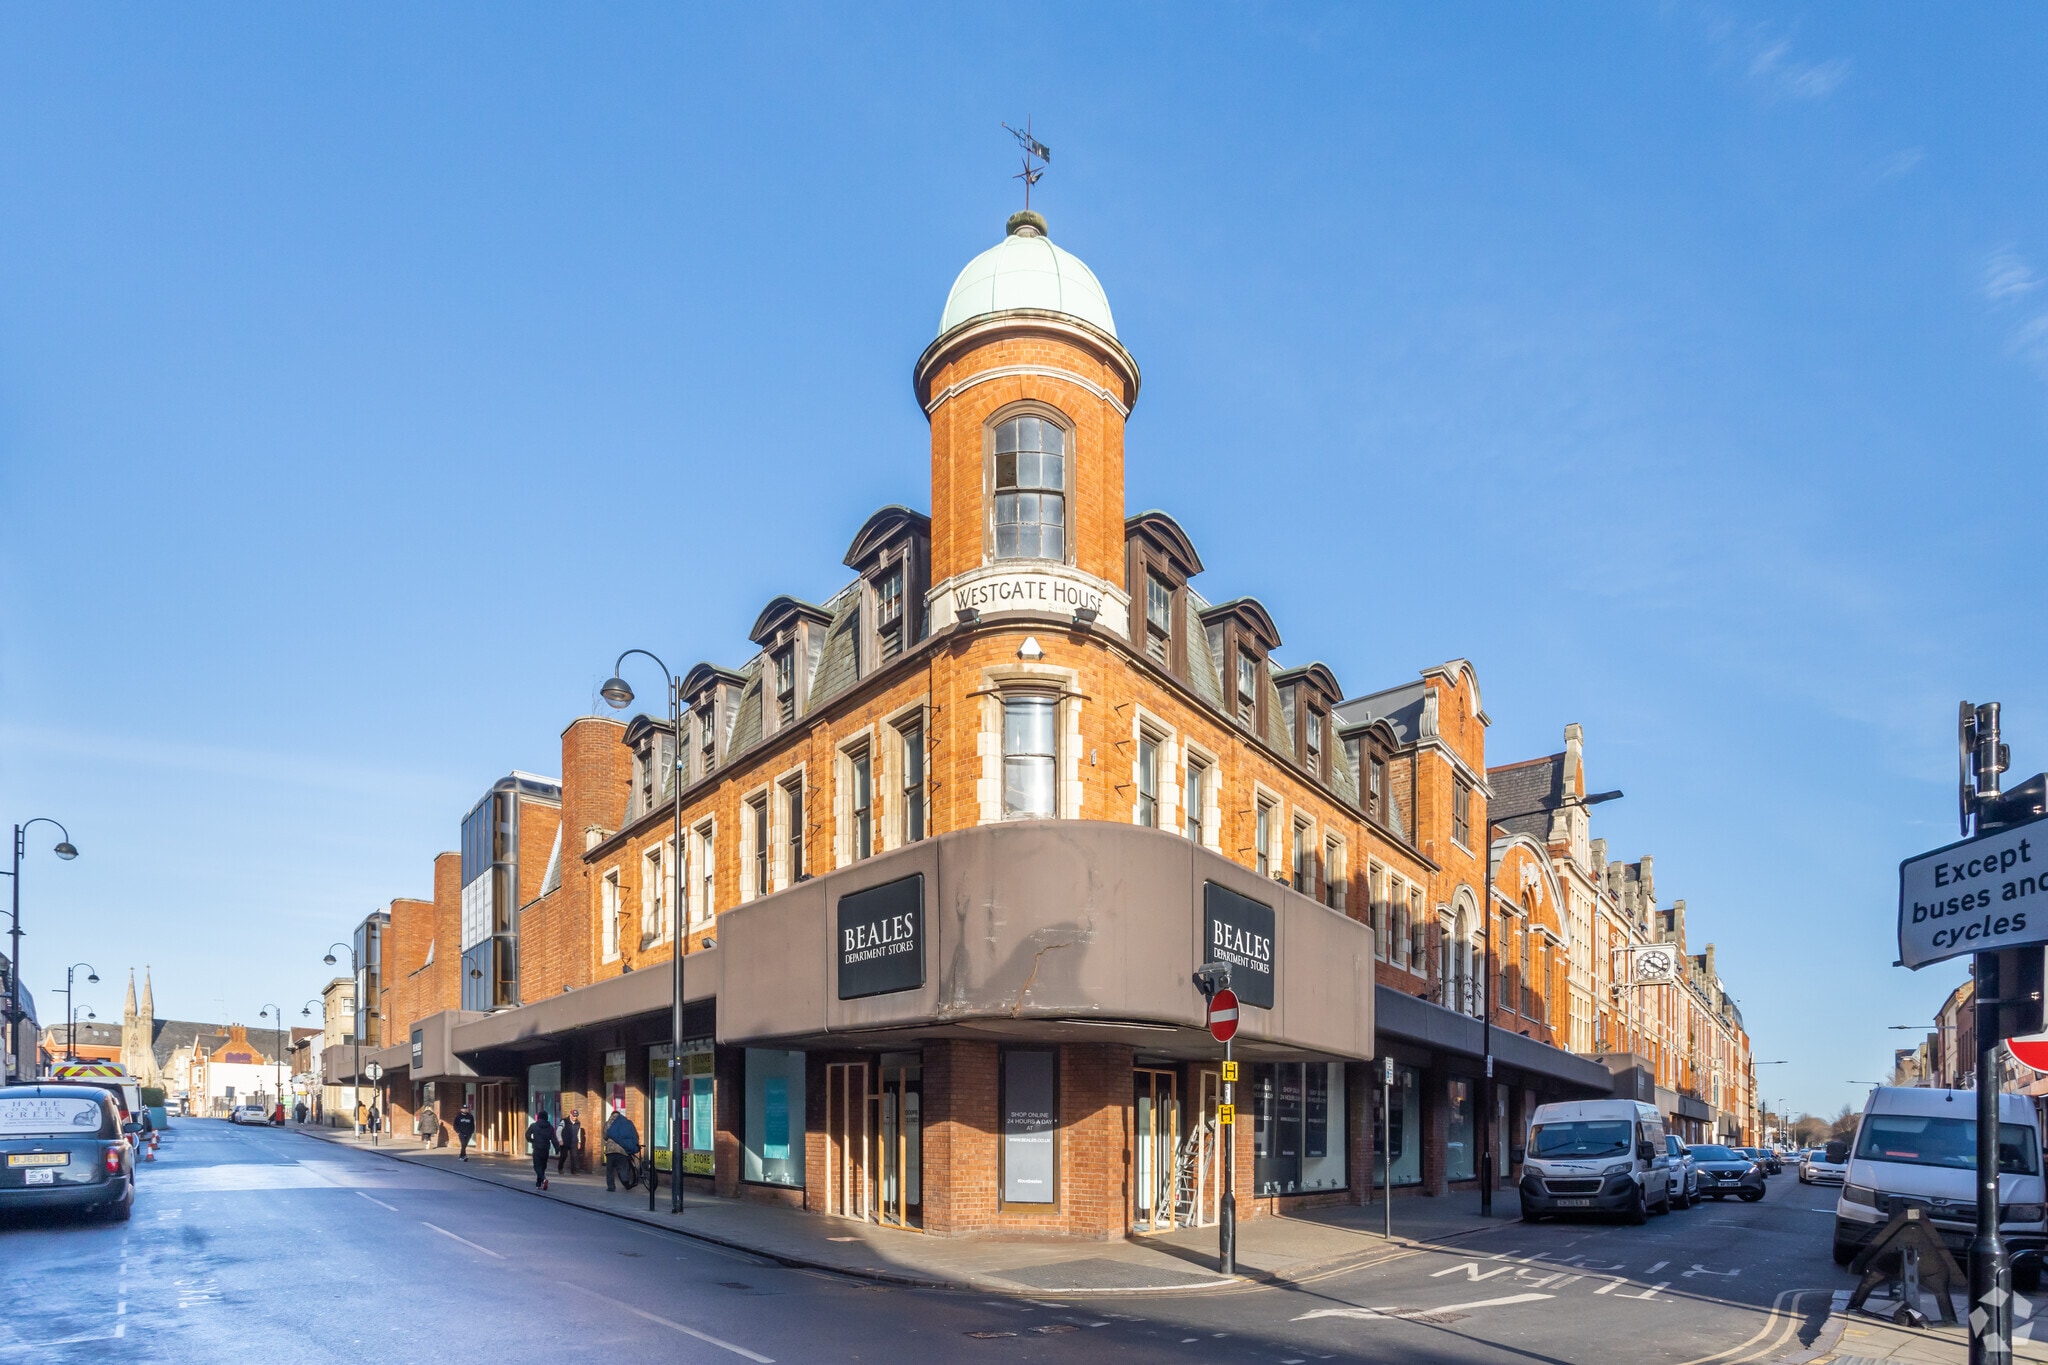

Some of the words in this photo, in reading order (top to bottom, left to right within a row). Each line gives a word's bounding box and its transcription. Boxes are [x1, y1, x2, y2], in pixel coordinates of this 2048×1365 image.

[956, 581, 1047, 610] WESTGATE
[1054, 581, 1103, 617] HOUSE
[1934, 838, 2031, 889] Except
[1912, 888, 1991, 924] buses
[844, 912, 914, 952] BEALES
[1213, 919, 1270, 962] BEALES
[1932, 912, 2027, 949] cycles
[845, 946, 887, 965] DEPARTMENT
[888, 940, 914, 955] STORES
[1213, 947, 1250, 968] DEPARTMENT
[1250, 959, 1270, 974] STORES
[1225, 1063, 1236, 1079] H
[1220, 1106, 1233, 1122] H
[693, 1153, 711, 1165] STORE
[1430, 1262, 1672, 1301] TURN
